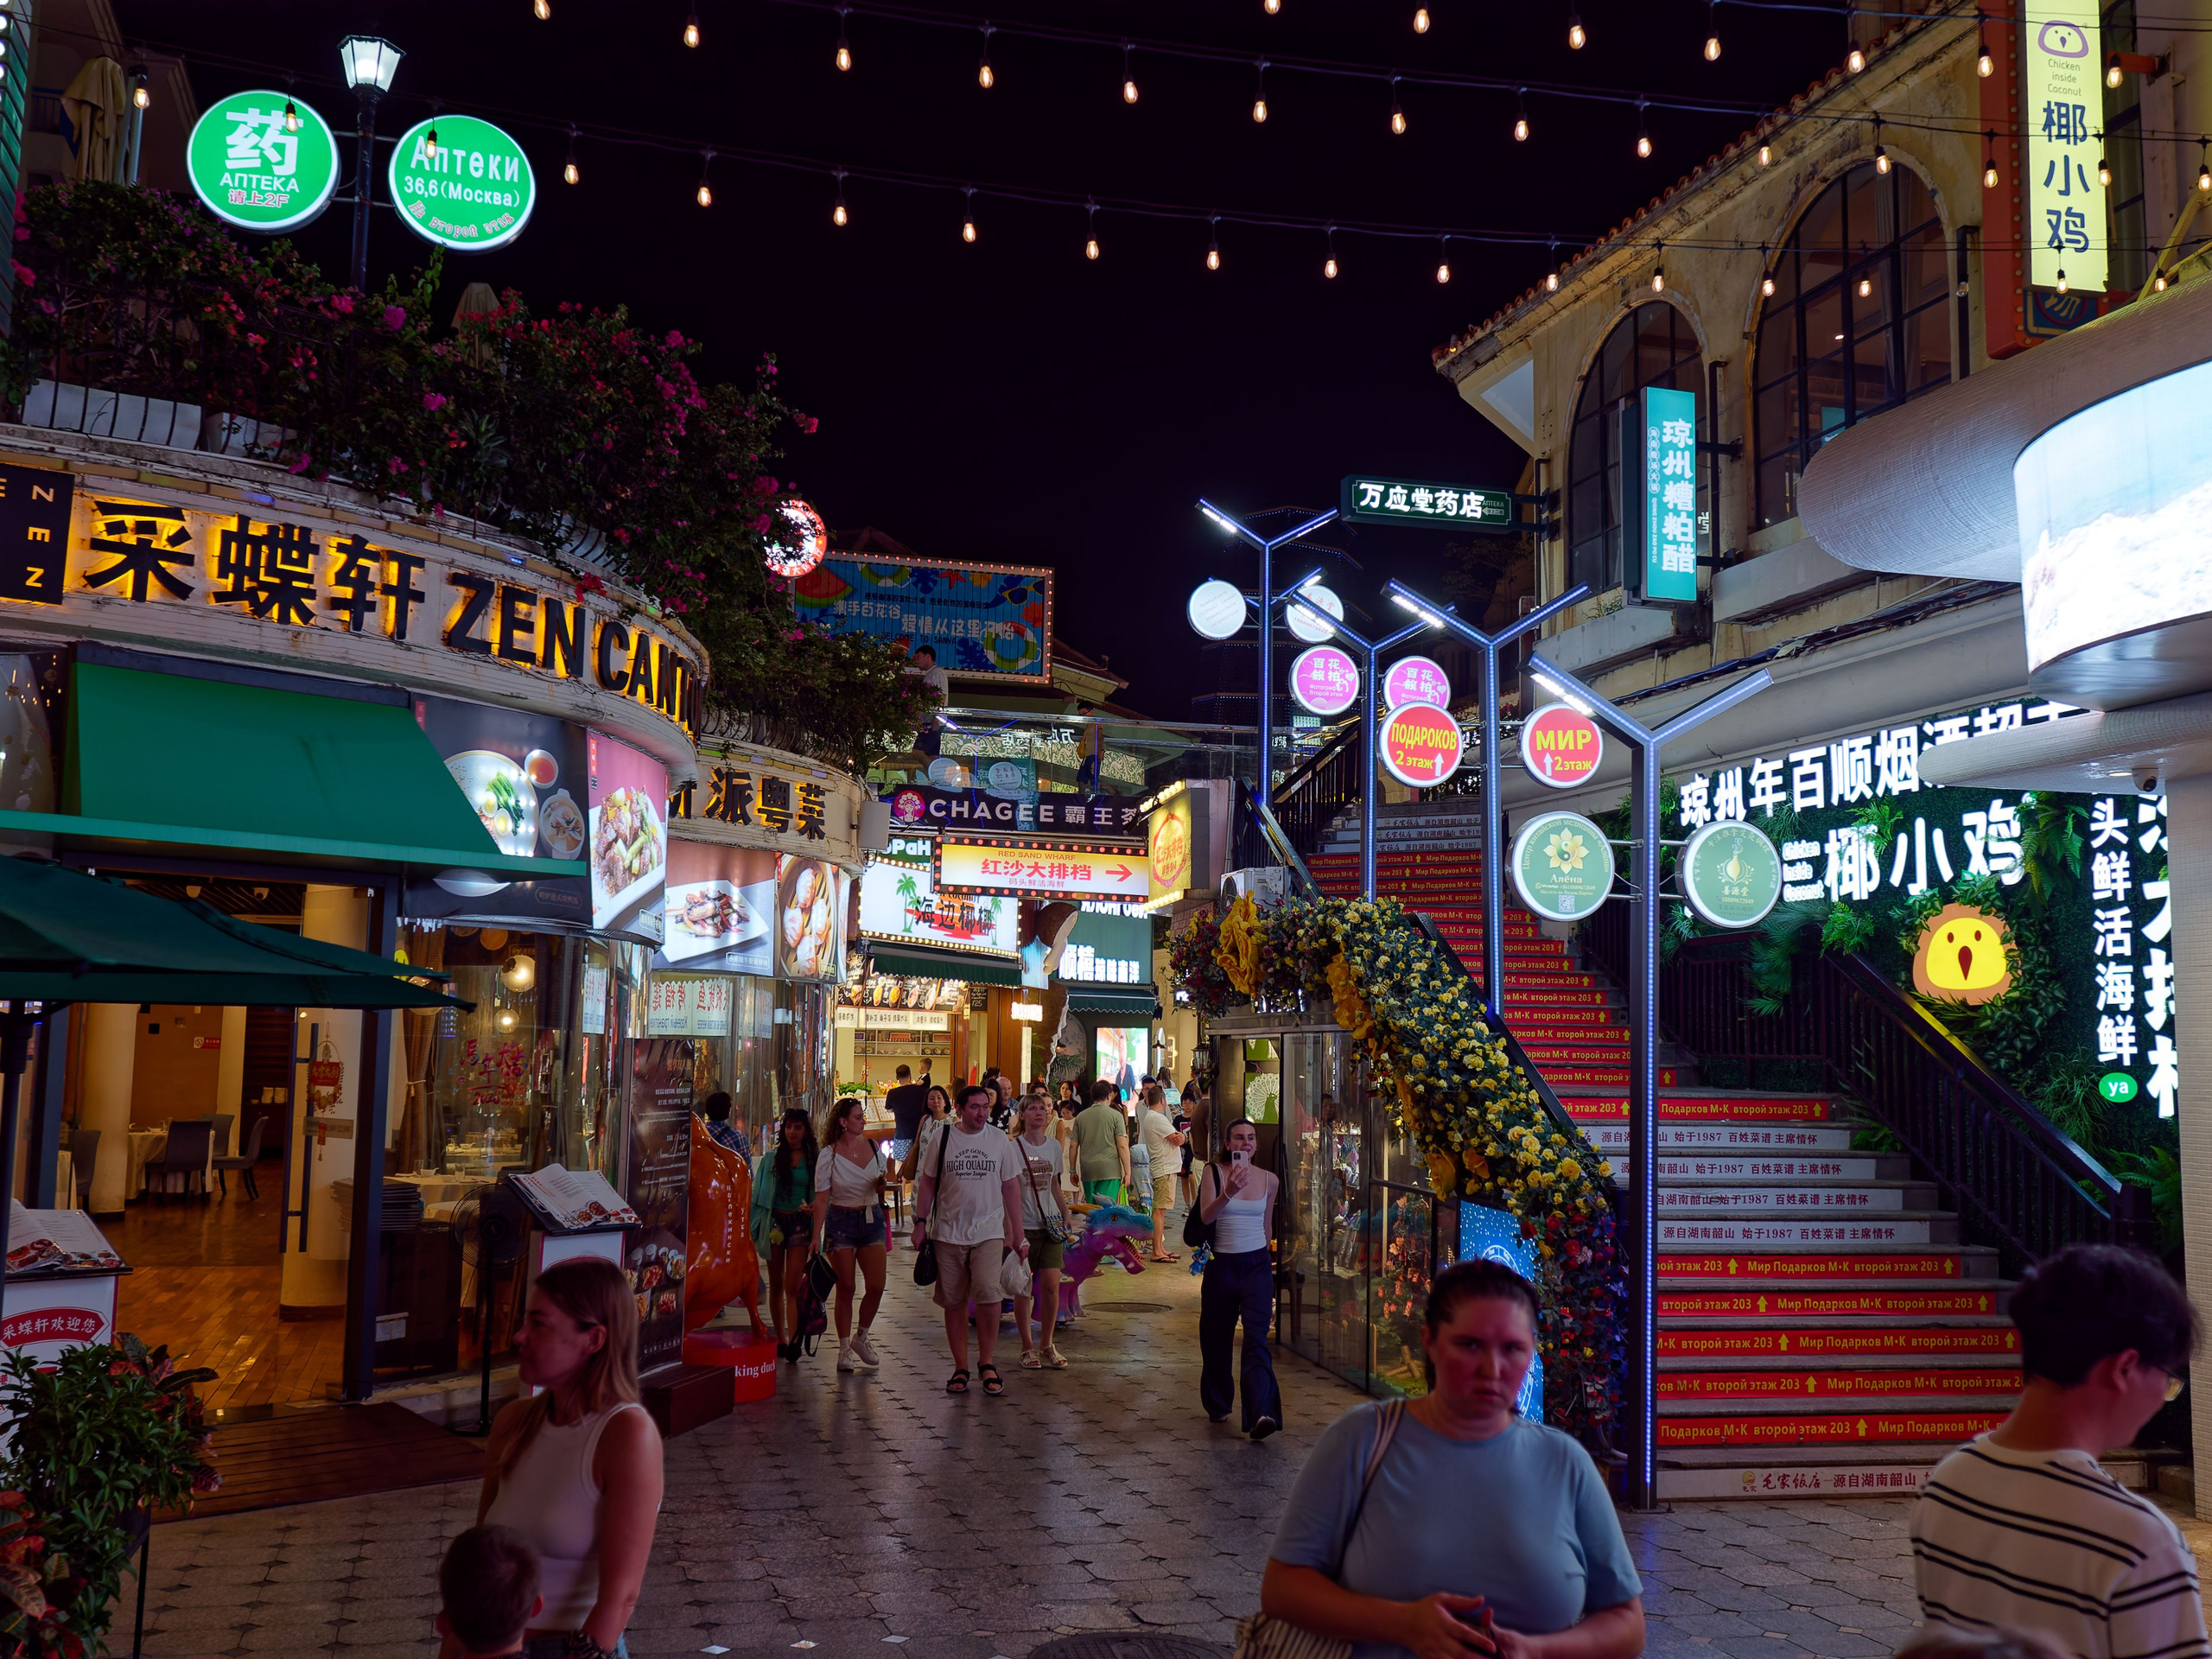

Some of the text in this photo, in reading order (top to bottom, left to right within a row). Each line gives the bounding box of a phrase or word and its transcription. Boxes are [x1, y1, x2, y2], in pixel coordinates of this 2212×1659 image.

[2047, 58, 2081, 72] Chicken
[2052, 72, 2077, 84] inside
[2047, 84, 2082, 97] Coconut
[226, 107, 303, 175] 药
[410, 135, 519, 183] Аптеки
[219, 172, 300, 194] АПТЕКА
[2042, 100, 2090, 252] 椰小鸡
[228, 189, 290, 208] 请上2F
[408, 200, 516, 238] На второй этаж
[1359, 483, 1485, 518] 万应堂药店
[1662, 418, 1695, 574] 琼州糟粕醋
[82, 499, 426, 643] 采蝶轩
[447, 570, 587, 677] ZEN
[901, 613, 1014, 641] 爱情从这里开始
[1313, 658, 1341, 670] 百花
[1407, 667, 1433, 681] 百花
[1391, 722, 1458, 750] ПОДАРОКОВ
[1535, 729, 1592, 751] МИР
[1395, 750, 1433, 770] 2 этаж
[929, 798, 1054, 823] CHAGEE
[1522, 845, 1534, 870] Центр
[1531, 820, 1562, 845] китайской
[1563, 819, 1599, 841] медицины
[1783, 839, 1821, 861] Chicken
[1824, 798, 2024, 902] 椰小鸡
[1017, 851, 1042, 860] SAND
[1045, 853, 1076, 861] WHARF
[1440, 854, 1468, 862] Подарков
[981, 858, 1092, 881] 红沙大排档
[1429, 867, 1459, 875] Подарков
[1008, 877, 1065, 888] 码头鲜活海鲜
[1426, 881, 1456, 891] Подарков
[1550, 874, 1583, 884] Алёна
[1408, 893, 1478, 903] Подарков второй
[1721, 885, 1749, 897] 善源堂
[1783, 879, 1825, 903] Coconut
[2090, 792, 2139, 1066] 头鲜活海鲜
[1523, 943, 1554, 952] этаж 203
[1528, 961, 1545, 969] этаж
[1519, 976, 1545, 986] второй
[1531, 993, 1557, 1002] второй
[1533, 1011, 1560, 1021] второй
[1556, 1029, 1619, 1039] второй 203
[1572, 1050, 1620, 1060] второй этаж
[1594, 1071, 1624, 1083] второй
[2108, 1079, 2130, 1096] ya
[1661, 1103, 1767, 1116] Подарков второй
[1728, 1132, 1818, 1145] 百姓菜谱 主席情怀
[955, 1147, 989, 1160] KEEP GOING
[946, 1160, 997, 1173] HIGH QUALITY
[1695, 1162, 1842, 1175] 始于1987 百姓菜谱 主席情怀
[1719, 1193, 1869, 1206] 始于1987 百姓菜谱 主席情怀
[1663, 1226, 1896, 1241] 源自湖南韶山 百姓菜谱 主席情怀
[1747, 1261, 1892, 1274] Мир Подарков второй
[1777, 1298, 1925, 1312] Мир Подарков второй
[3, 1316, 96, 1341] 采蝶轩欢迎您
[1799, 1335, 1950, 1350] Мир Подарков второй
[1707, 1377, 1912, 1394] второй Мир Подарков
[1661, 1419, 1964, 1440] Подарков Мир Подарков
[1762, 1472, 1916, 1491] 毛家饭店 源自湖南韶山
